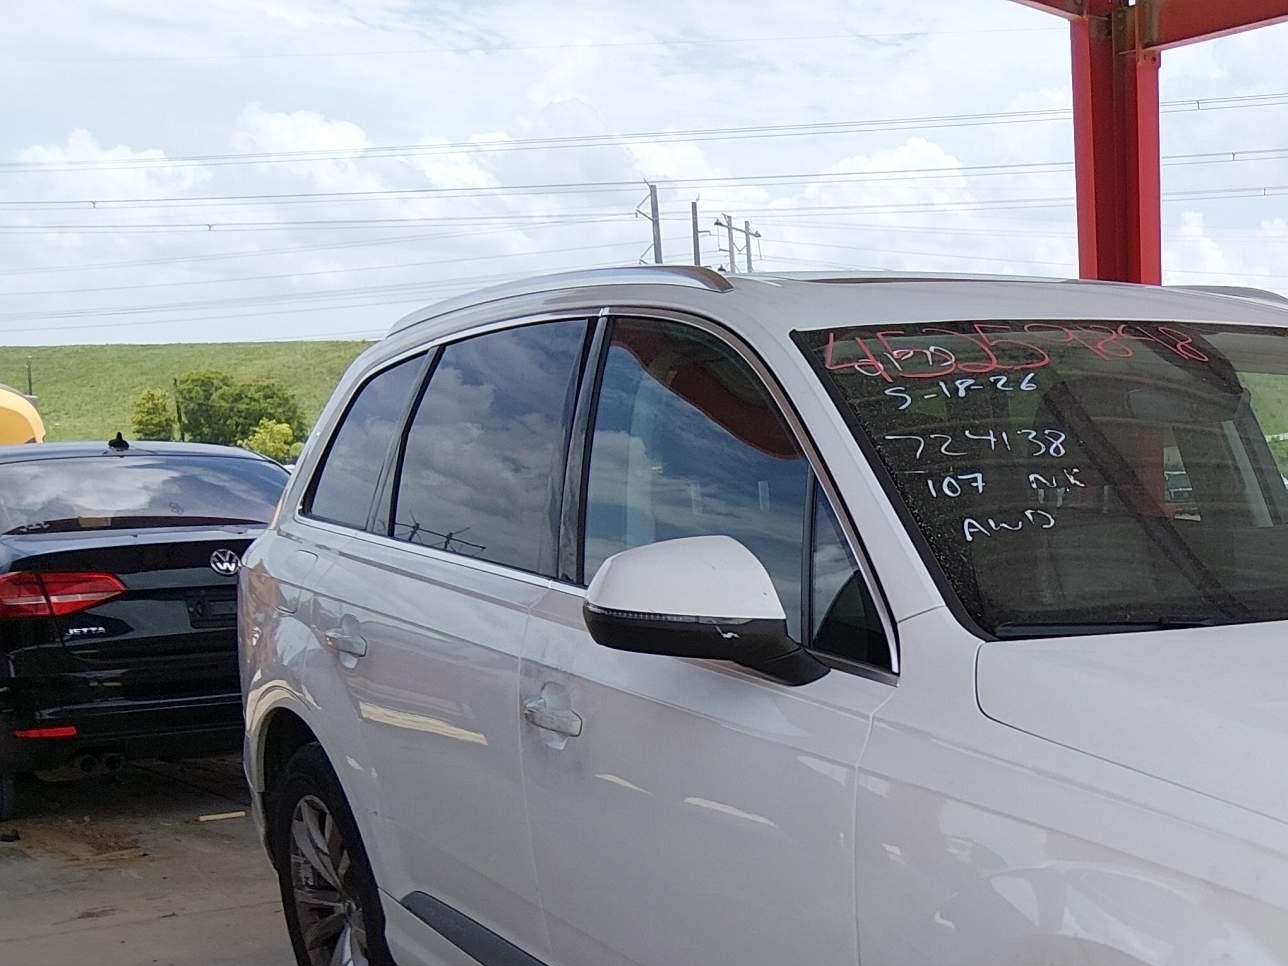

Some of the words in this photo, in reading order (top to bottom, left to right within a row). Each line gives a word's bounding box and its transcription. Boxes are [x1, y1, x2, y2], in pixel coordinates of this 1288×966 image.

[884, 429, 1066, 459] 724138
[962, 509, 1055, 542] AWD
[66, 626, 106, 636] JETTA
